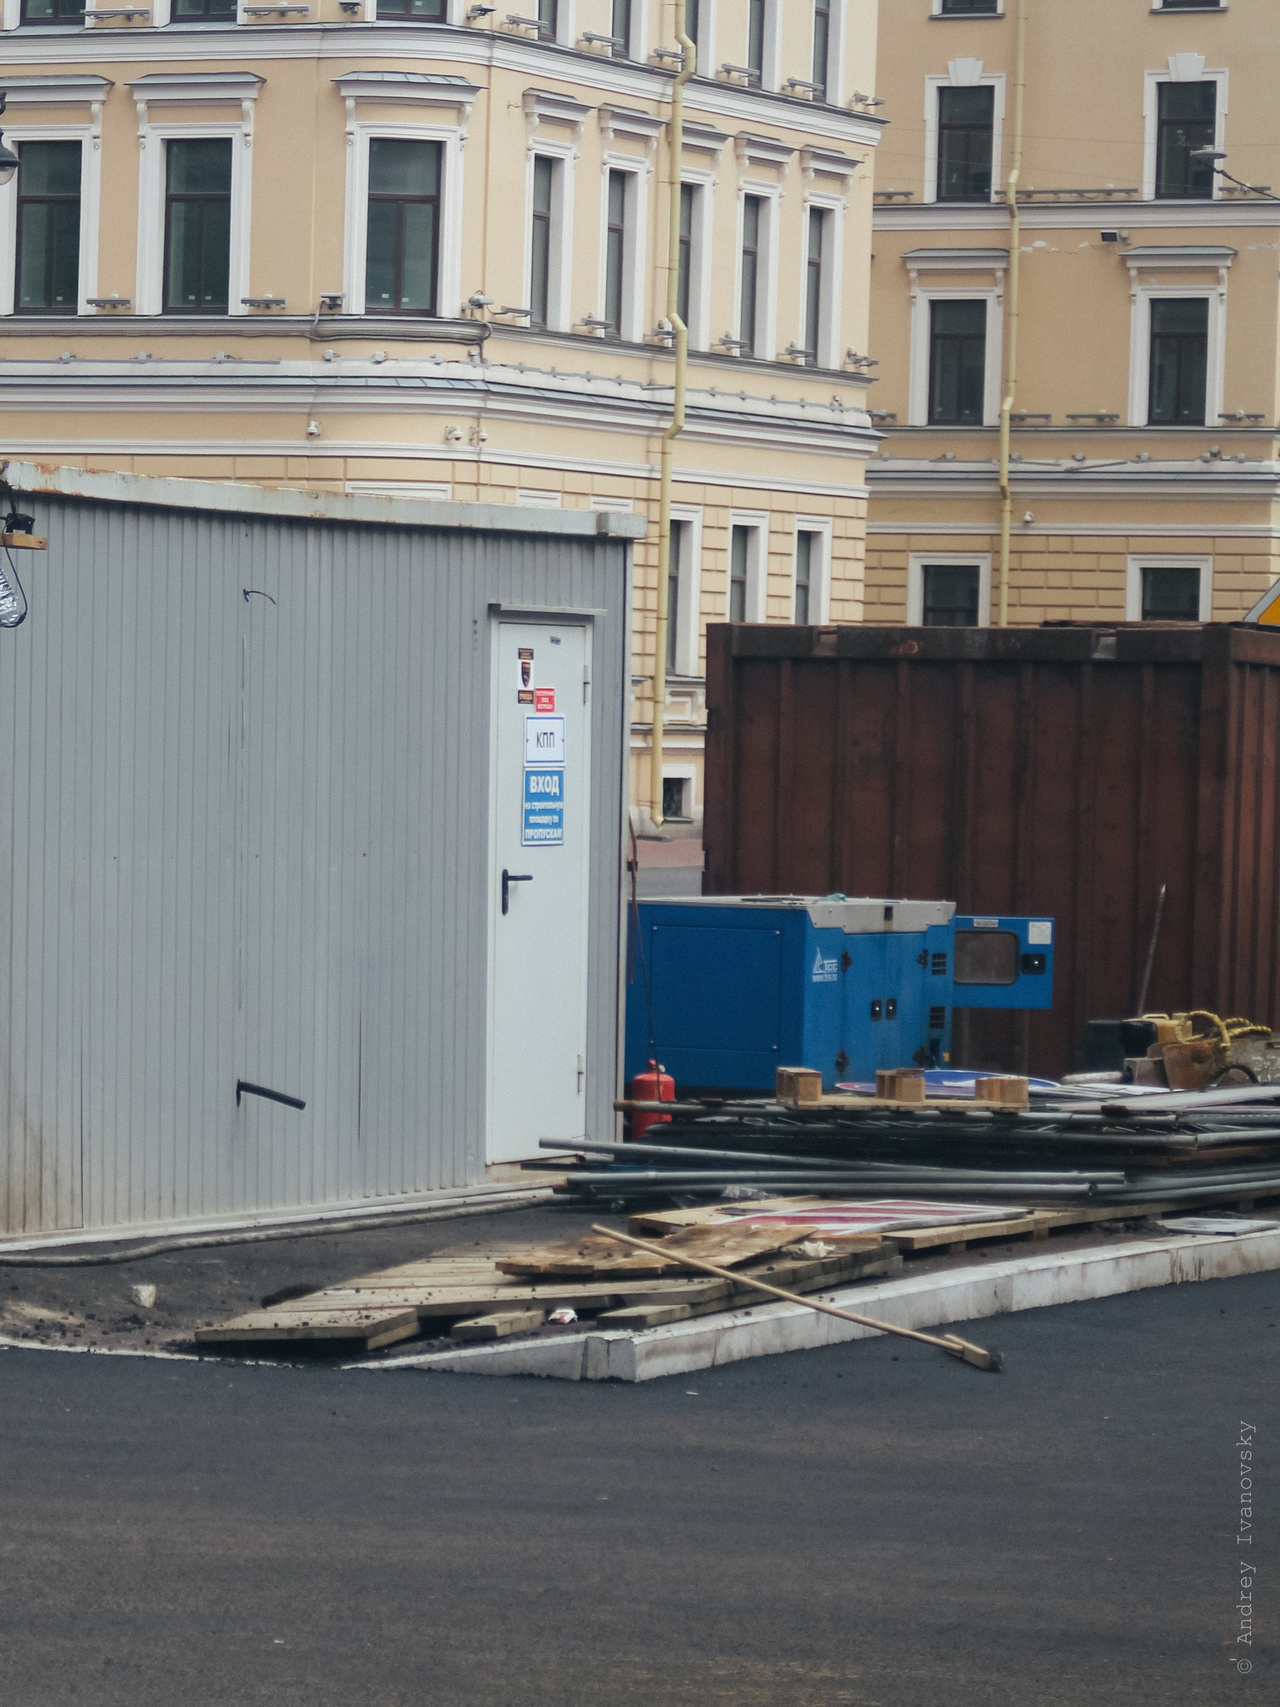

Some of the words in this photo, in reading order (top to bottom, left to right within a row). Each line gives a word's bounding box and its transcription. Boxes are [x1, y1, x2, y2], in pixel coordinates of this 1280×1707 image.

[536, 731, 555, 749] КПП
[530, 775, 560, 796] ВХОД
[525, 828, 562, 840] ПРОПУСКАМ
